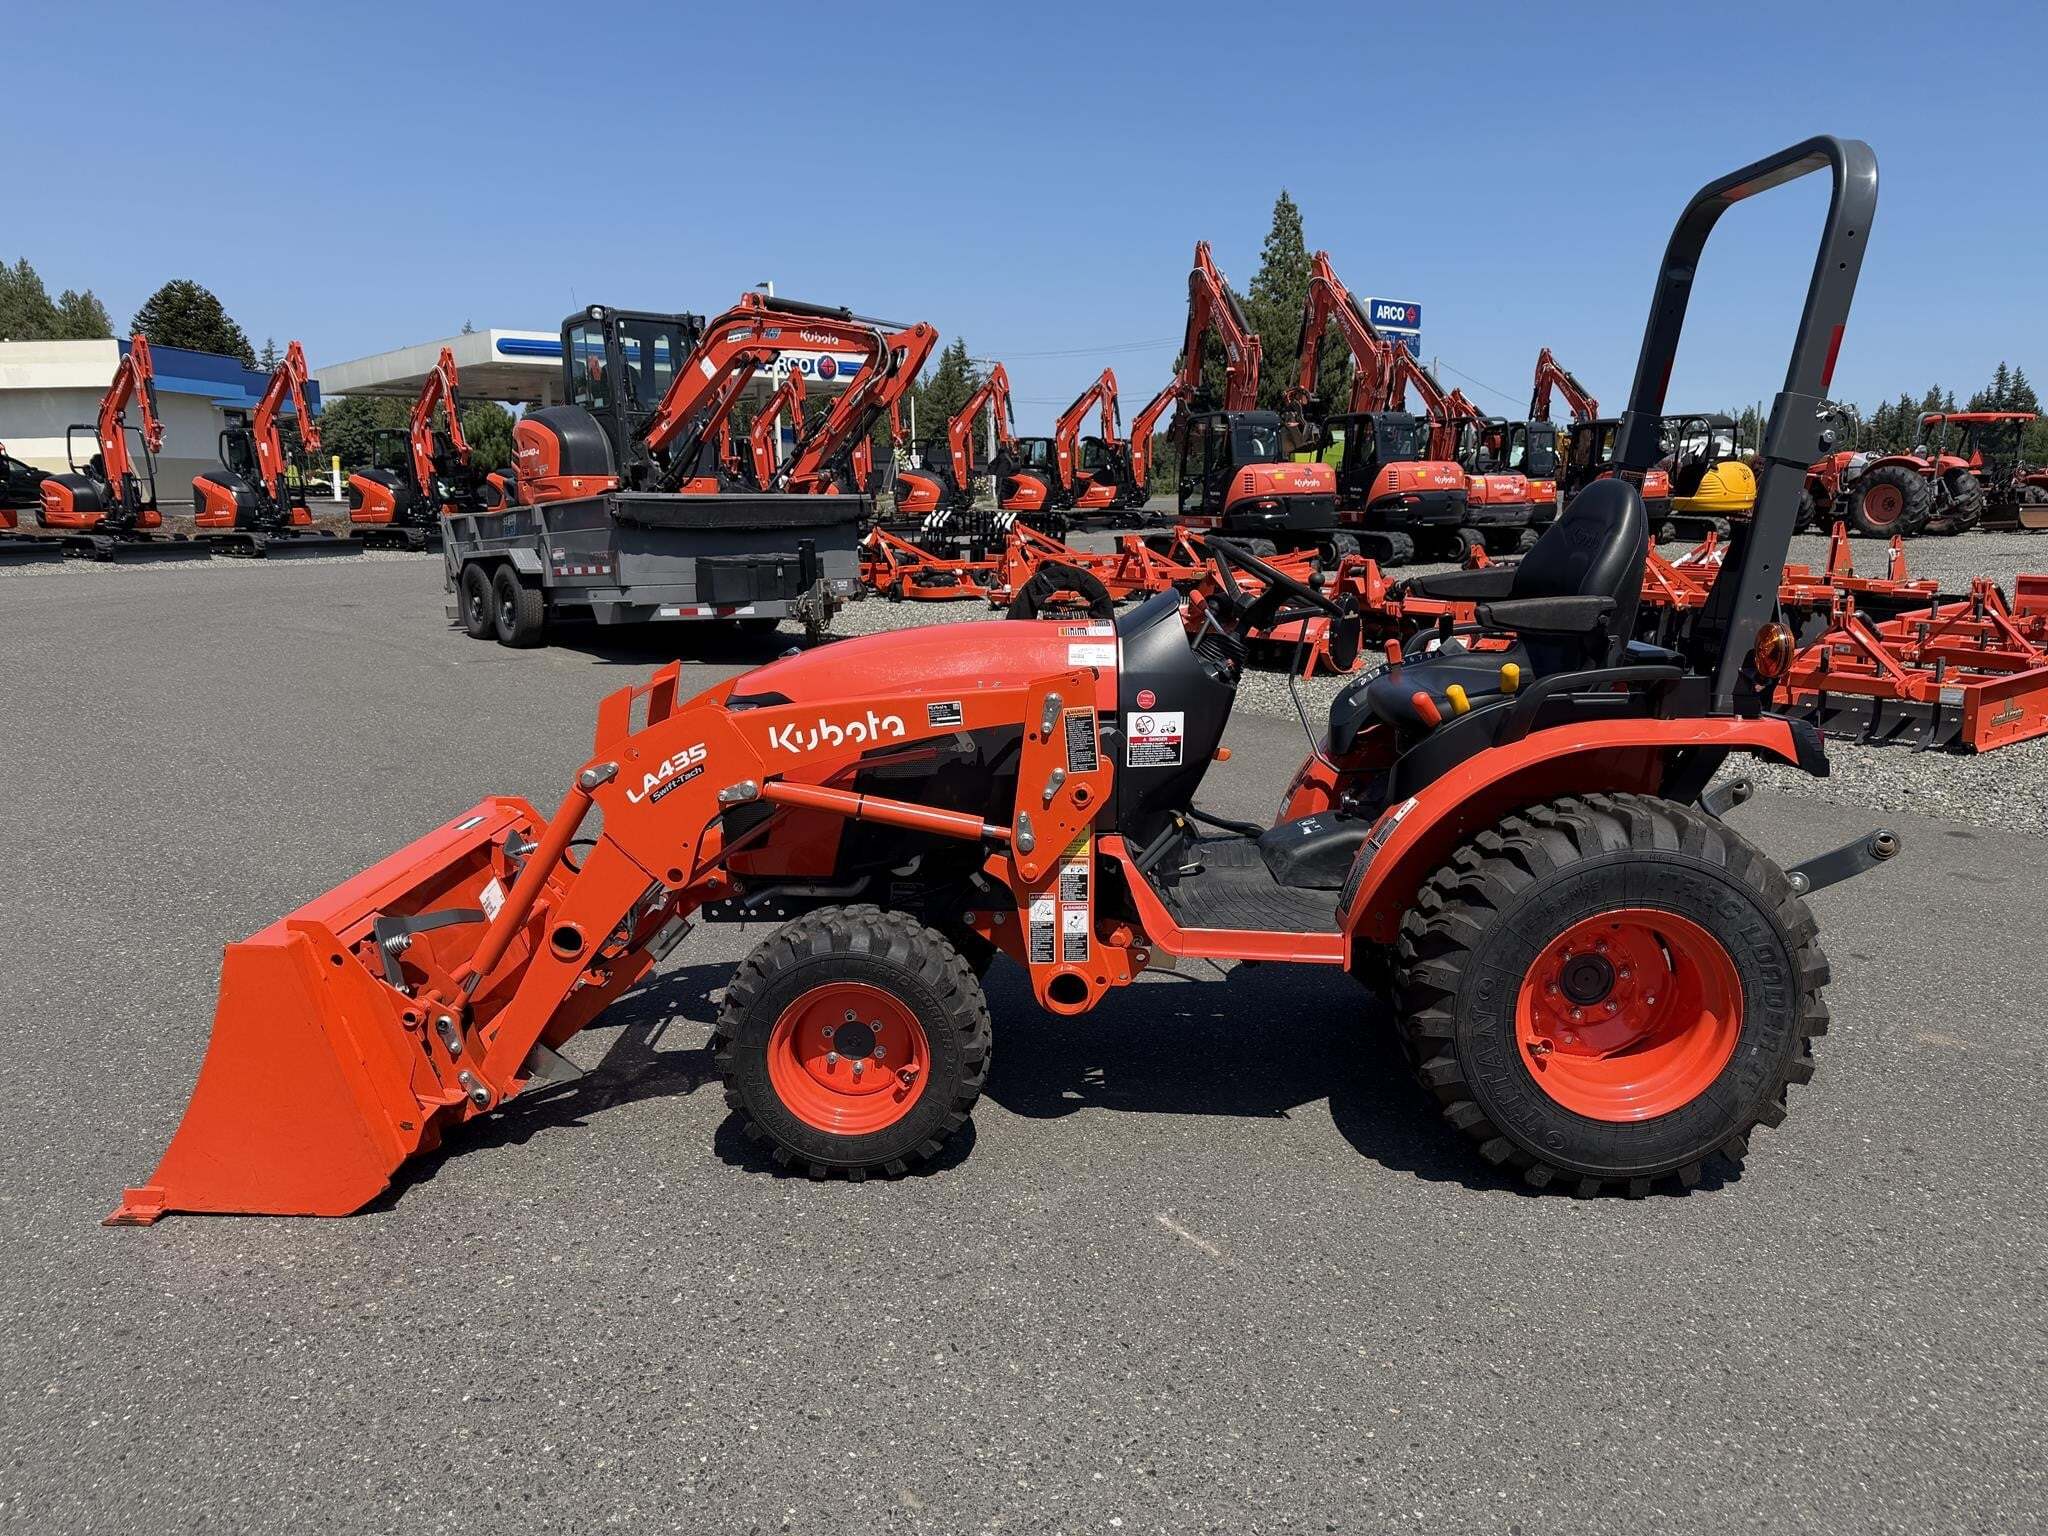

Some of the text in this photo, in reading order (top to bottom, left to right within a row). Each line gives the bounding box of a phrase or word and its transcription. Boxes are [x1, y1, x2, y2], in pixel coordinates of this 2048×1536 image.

[1377, 304, 1405, 321] ARCO
[800, 329, 840, 346] Kubota
[1294, 478, 1321, 488] Kubota
[1435, 475, 1457, 484] Kubota
[769, 711, 905, 753] Kubota
[626, 743, 708, 804] LA435
[653, 766, 703, 801] Swift-Tach
[1472, 1005, 1547, 1136] TITAN
